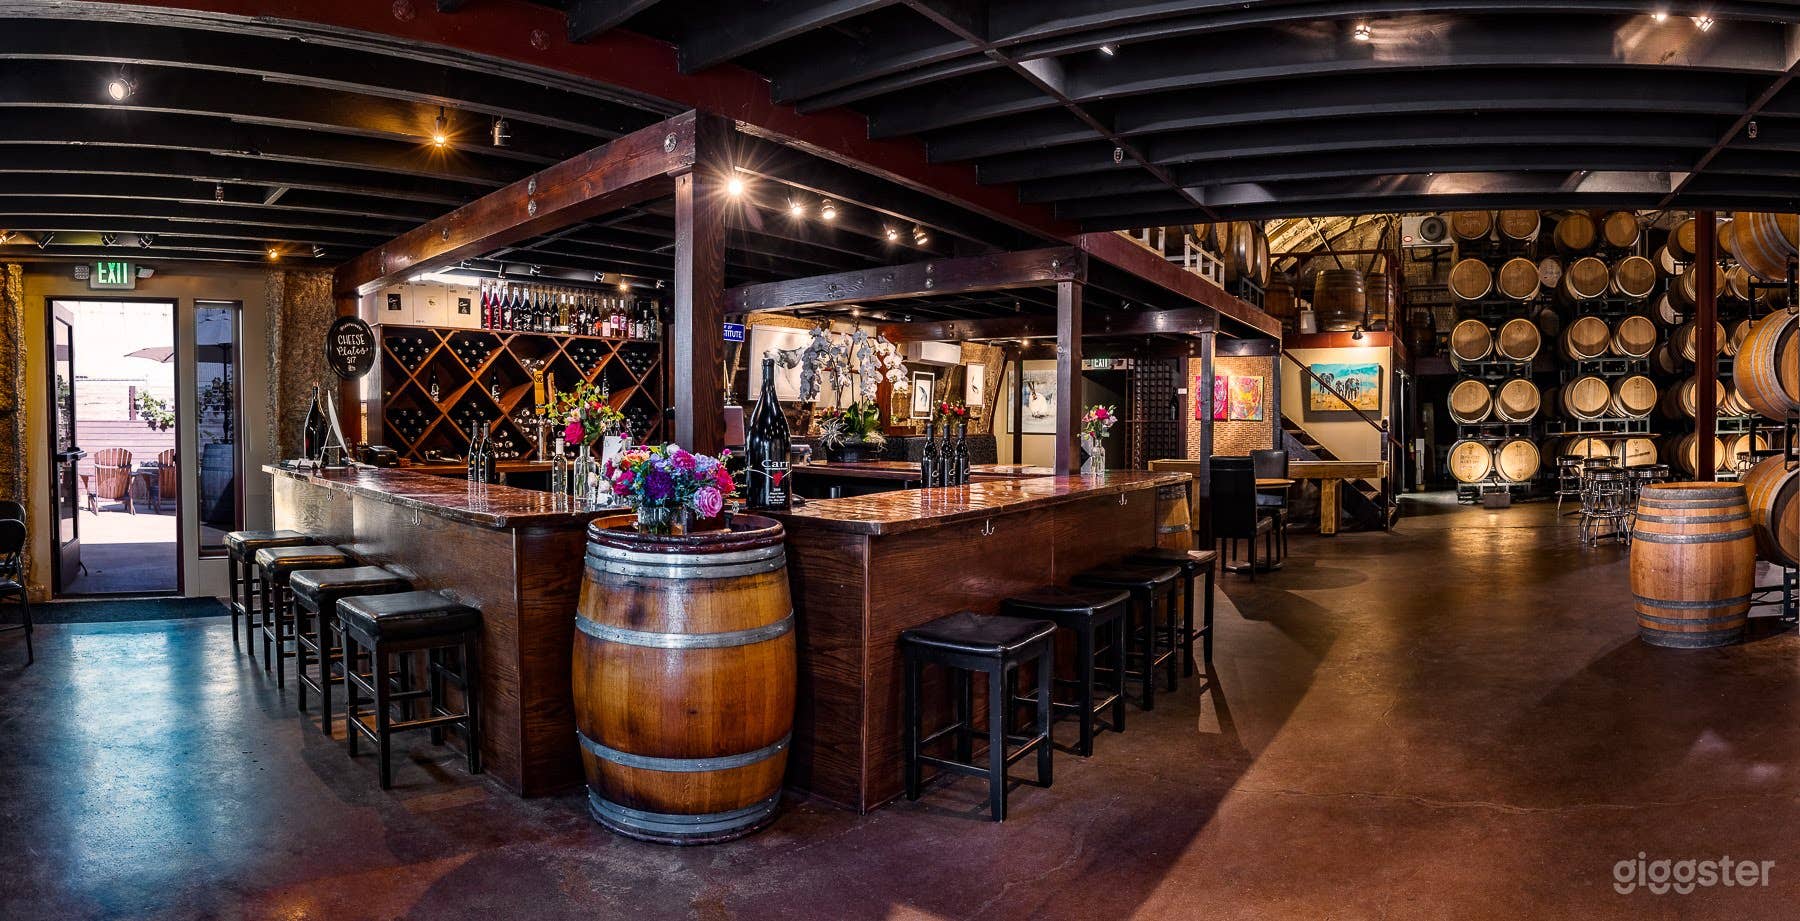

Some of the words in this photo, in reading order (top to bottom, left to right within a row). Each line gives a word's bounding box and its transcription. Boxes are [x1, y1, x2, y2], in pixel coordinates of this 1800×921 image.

[97, 262, 128, 284] EXIT
[337, 334, 365, 345] CHEESE
[723, 330, 743, 340] TITUTE
[336, 346, 369, 356] Plates
[1094, 358, 1108, 368] EXIT
[761, 460, 790, 468] Carr
